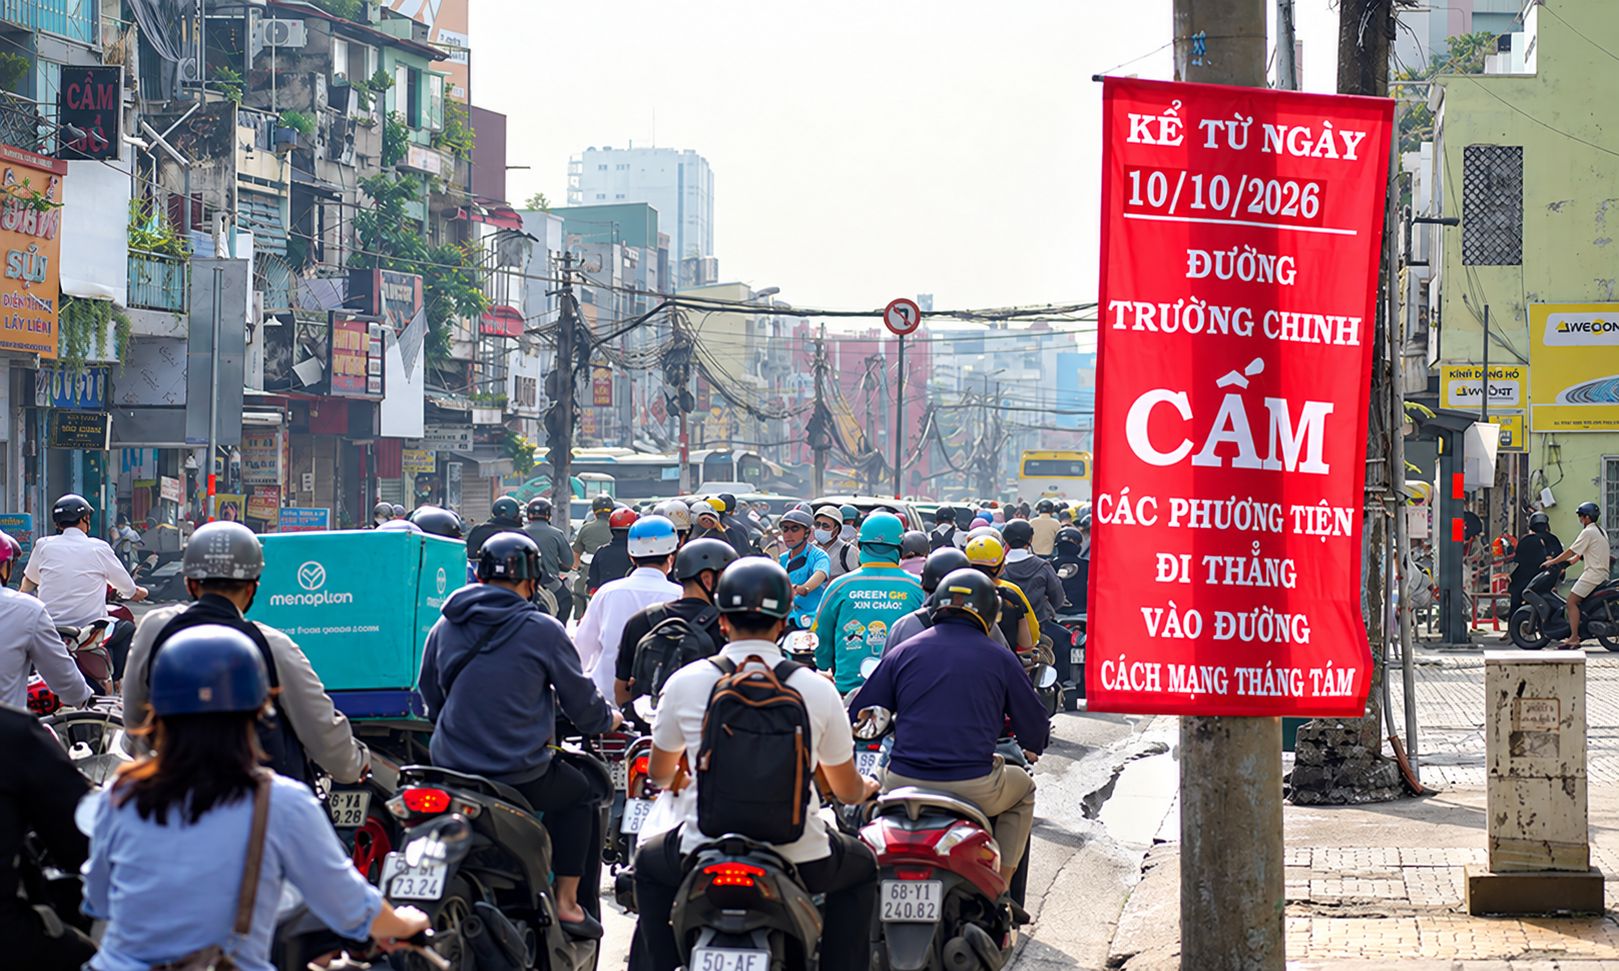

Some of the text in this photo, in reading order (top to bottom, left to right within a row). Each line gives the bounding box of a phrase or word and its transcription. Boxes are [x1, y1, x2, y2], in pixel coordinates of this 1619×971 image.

[1126, 100, 1366, 160] KỂ TỪ NGÀY
[1128, 170, 1320, 219] 10/10/2026
[1186, 244, 1296, 285] ĐƯỜNG
[1108, 296, 1362, 345] TRƯỜNG CHINH
[1125, 357, 1335, 475] CẤM
[1097, 486, 1355, 542] CÁC PHƯƠNG TIỆN
[1155, 540, 1297, 588] ĐI THẲNG
[848, 590, 888, 600] GREEN
[853, 601, 871, 610] XIN
[1141, 600, 1311, 643] VÀO ĐƯỜNG
[1100, 653, 1161, 692] CÁCH
[1167, 663, 1228, 700] MẠNG
[1234, 660, 1304, 697] THÁNG
[1309, 660, 1356, 697] TÁM
[394, 878, 438, 896] 73.24
[891, 884, 929, 900] 68-Y1
[884, 902, 935, 918] 240.82
